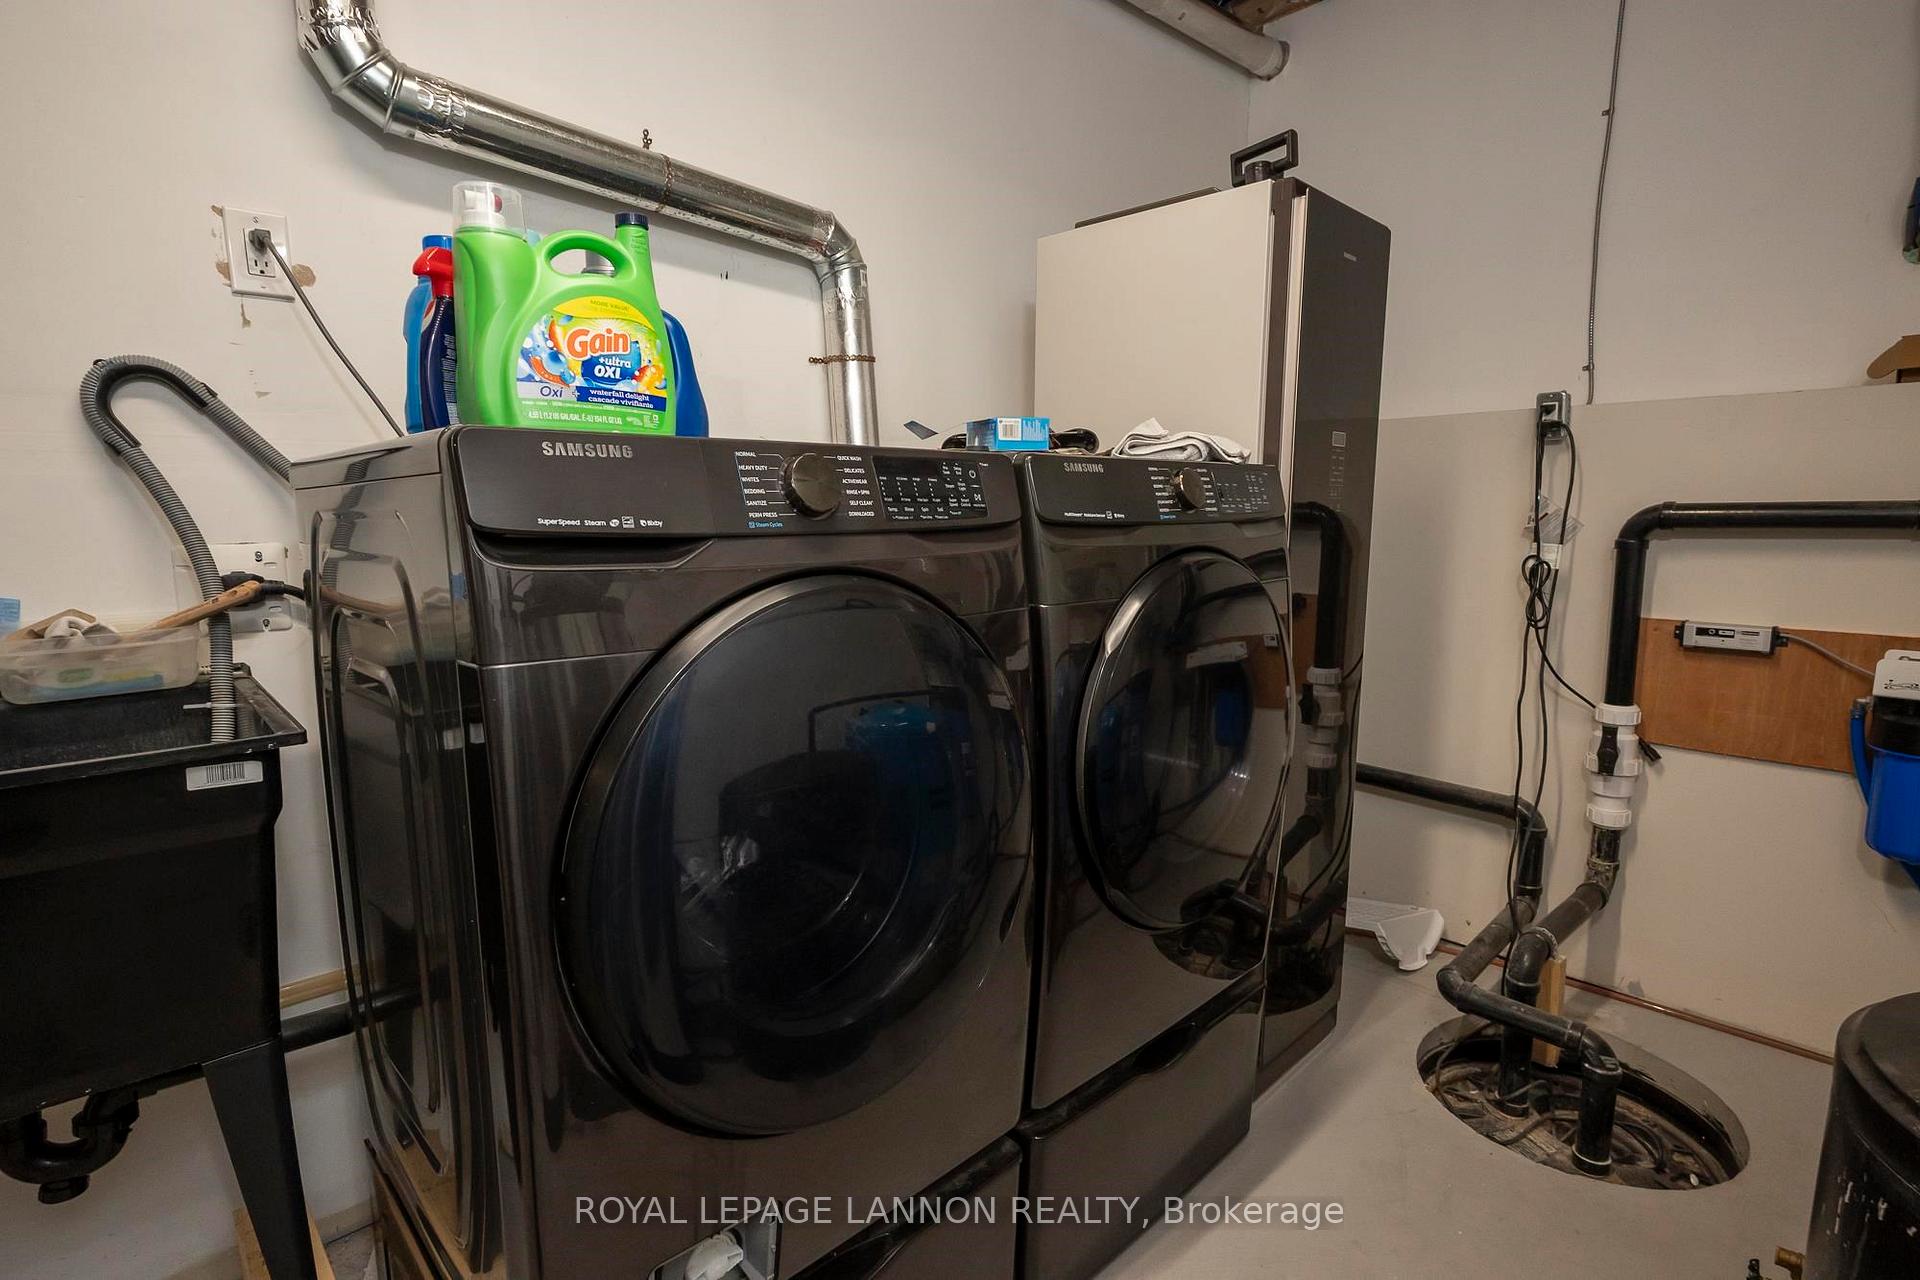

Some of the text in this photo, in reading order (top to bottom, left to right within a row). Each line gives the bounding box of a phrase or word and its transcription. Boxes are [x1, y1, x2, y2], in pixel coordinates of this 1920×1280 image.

[566, 327, 630, 359] Gain
[599, 356, 631, 369] +ultra
[594, 365, 621, 379] OXI
[540, 386, 563, 398] Oxi
[590, 388, 650, 402] waterfall delight
[588, 396, 620, 405] cascade
[620, 398, 654, 409] vivifiante
[542, 441, 633, 458] SAMSUNG
[1064, 462, 1104, 472] SAMSUNG
[538, 518, 580, 526] SuperSpeed
